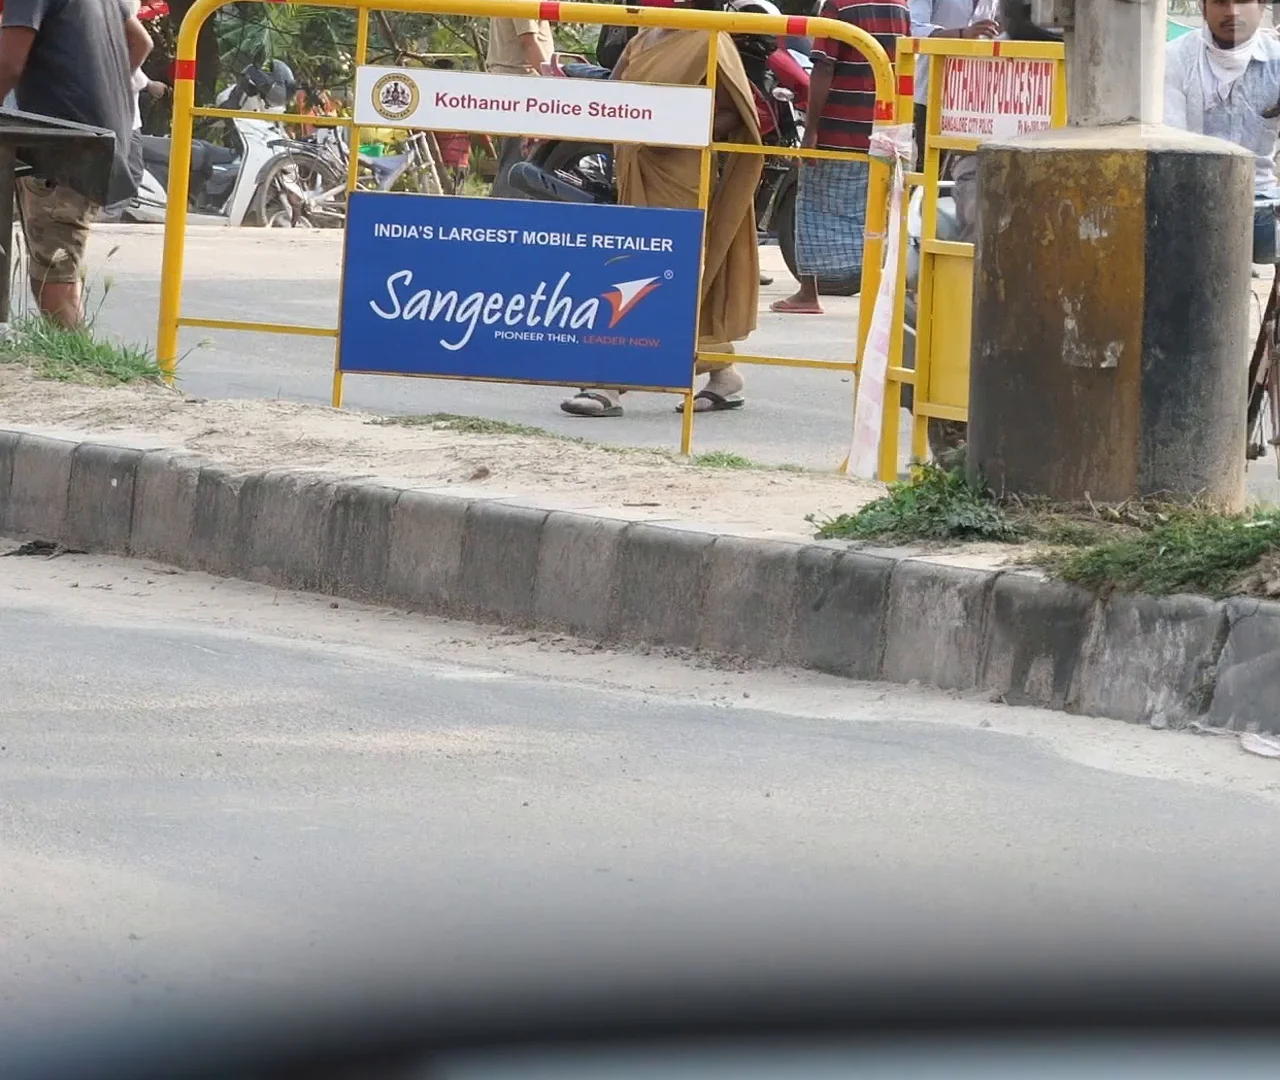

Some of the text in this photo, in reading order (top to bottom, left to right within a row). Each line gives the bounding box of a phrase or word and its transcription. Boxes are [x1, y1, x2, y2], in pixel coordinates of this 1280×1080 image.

[942, 57, 992, 113] KOTHANUR
[992, 60, 1024, 115] POLICE
[434, 92, 653, 120] Kothanur Police Station
[374, 223, 673, 253] INDIA'S LARGEST MOBILE RETAILER
[369, 269, 600, 351] Sangeetha
[494, 330, 545, 342] PIONEER
[547, 333, 579, 344] THEN,
[583, 335, 626, 346] LEADER
